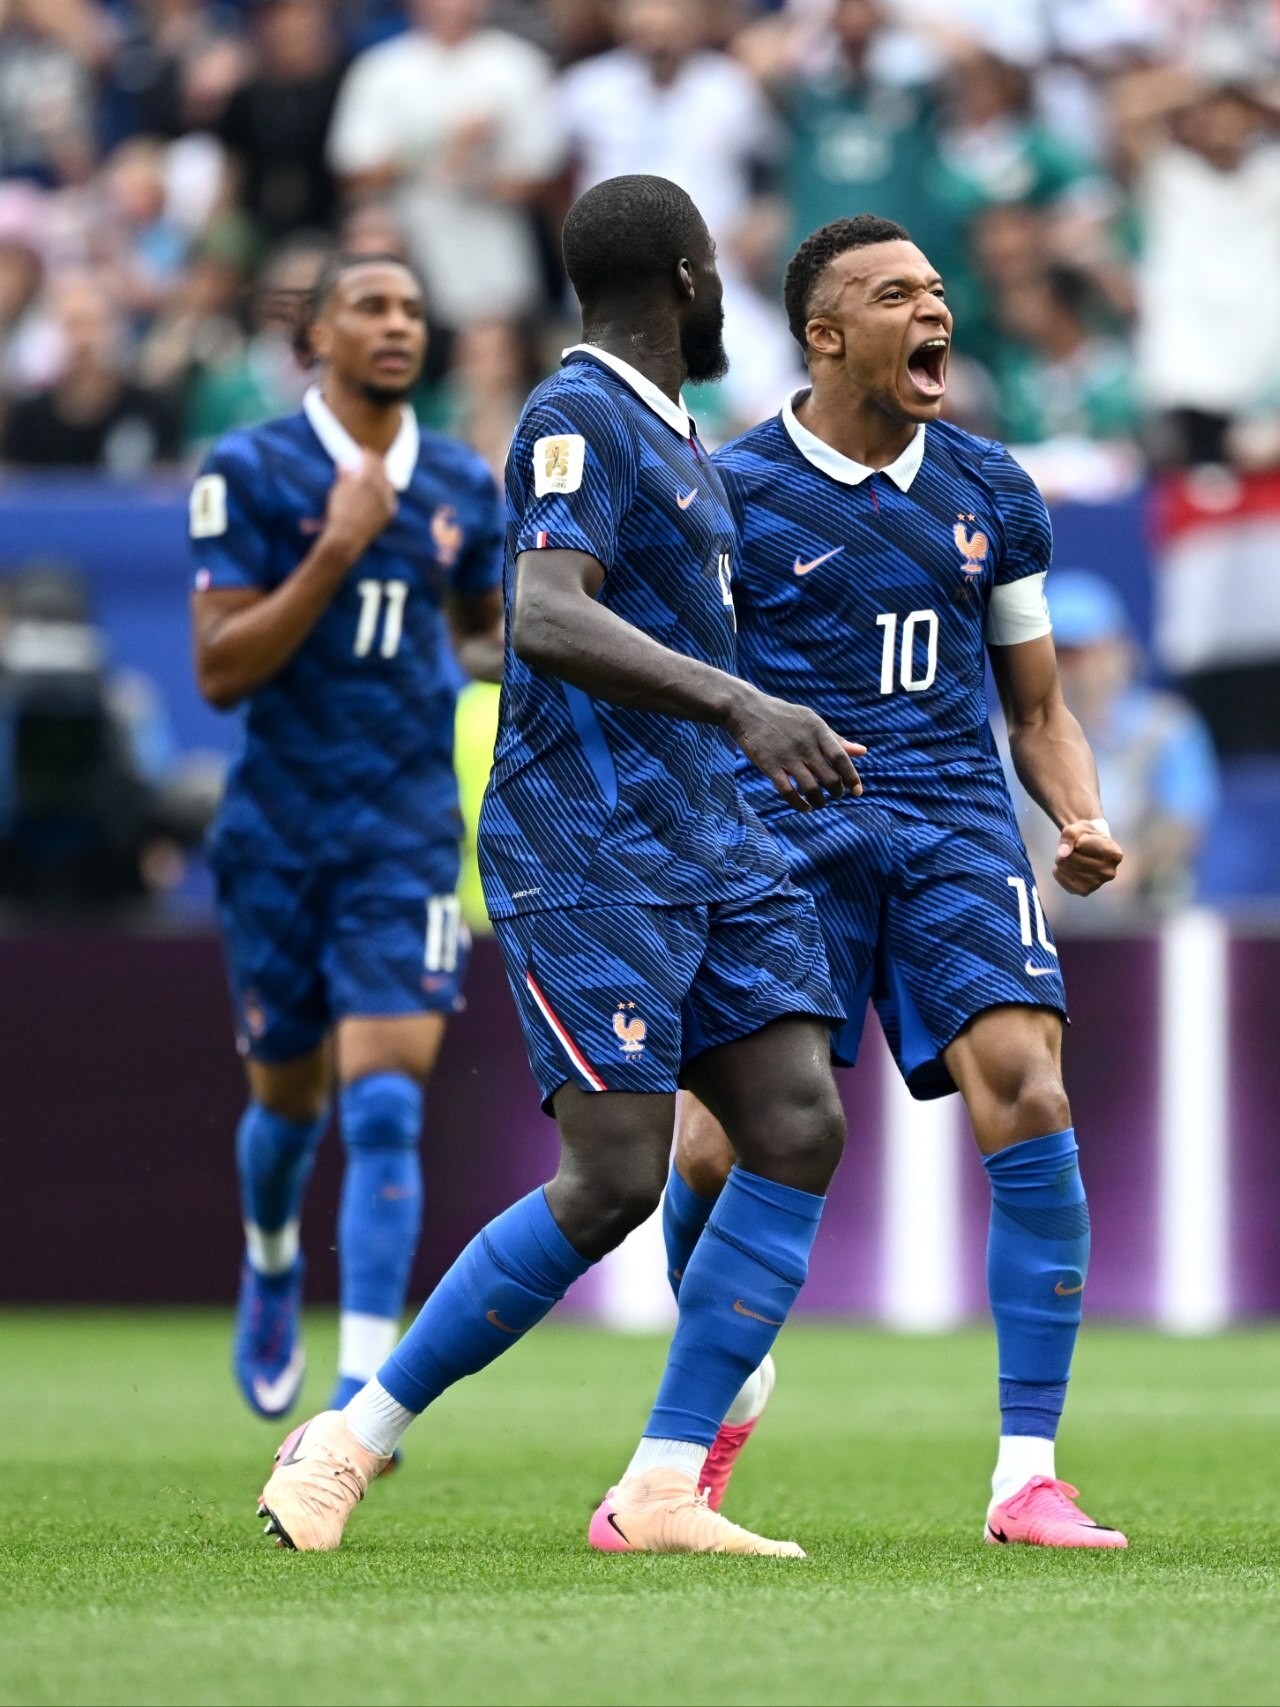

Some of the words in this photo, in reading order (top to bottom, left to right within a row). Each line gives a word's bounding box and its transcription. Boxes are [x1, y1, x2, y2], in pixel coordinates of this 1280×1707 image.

[354, 579, 408, 659] 11
[876, 609, 939, 695] 10
[425, 896, 460, 972] 11
